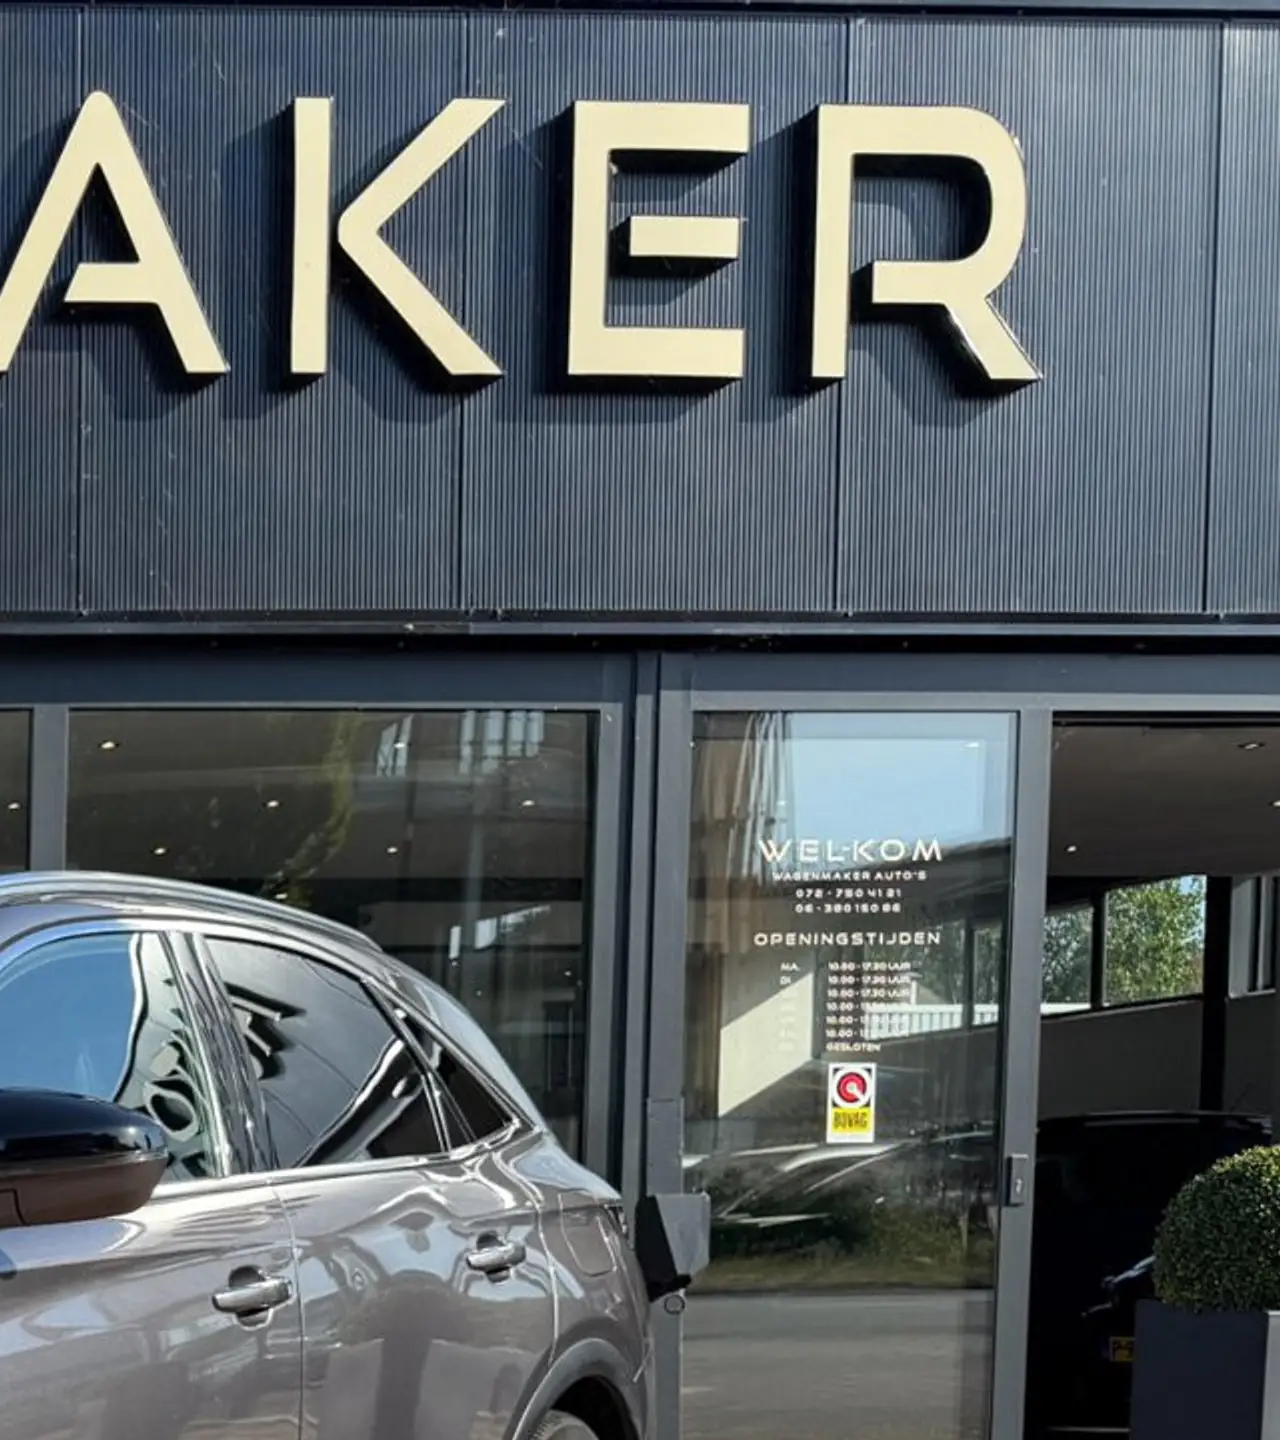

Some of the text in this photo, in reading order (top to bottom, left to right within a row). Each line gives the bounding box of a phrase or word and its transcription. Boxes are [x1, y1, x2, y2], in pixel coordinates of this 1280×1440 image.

[758, 839, 942, 862] WELKOM
[772, 871, 871, 881] WAGENMAKER
[754, 932, 941, 945] OPENINGSTIJDEN
[834, 1111, 868, 1130] BOVAG
